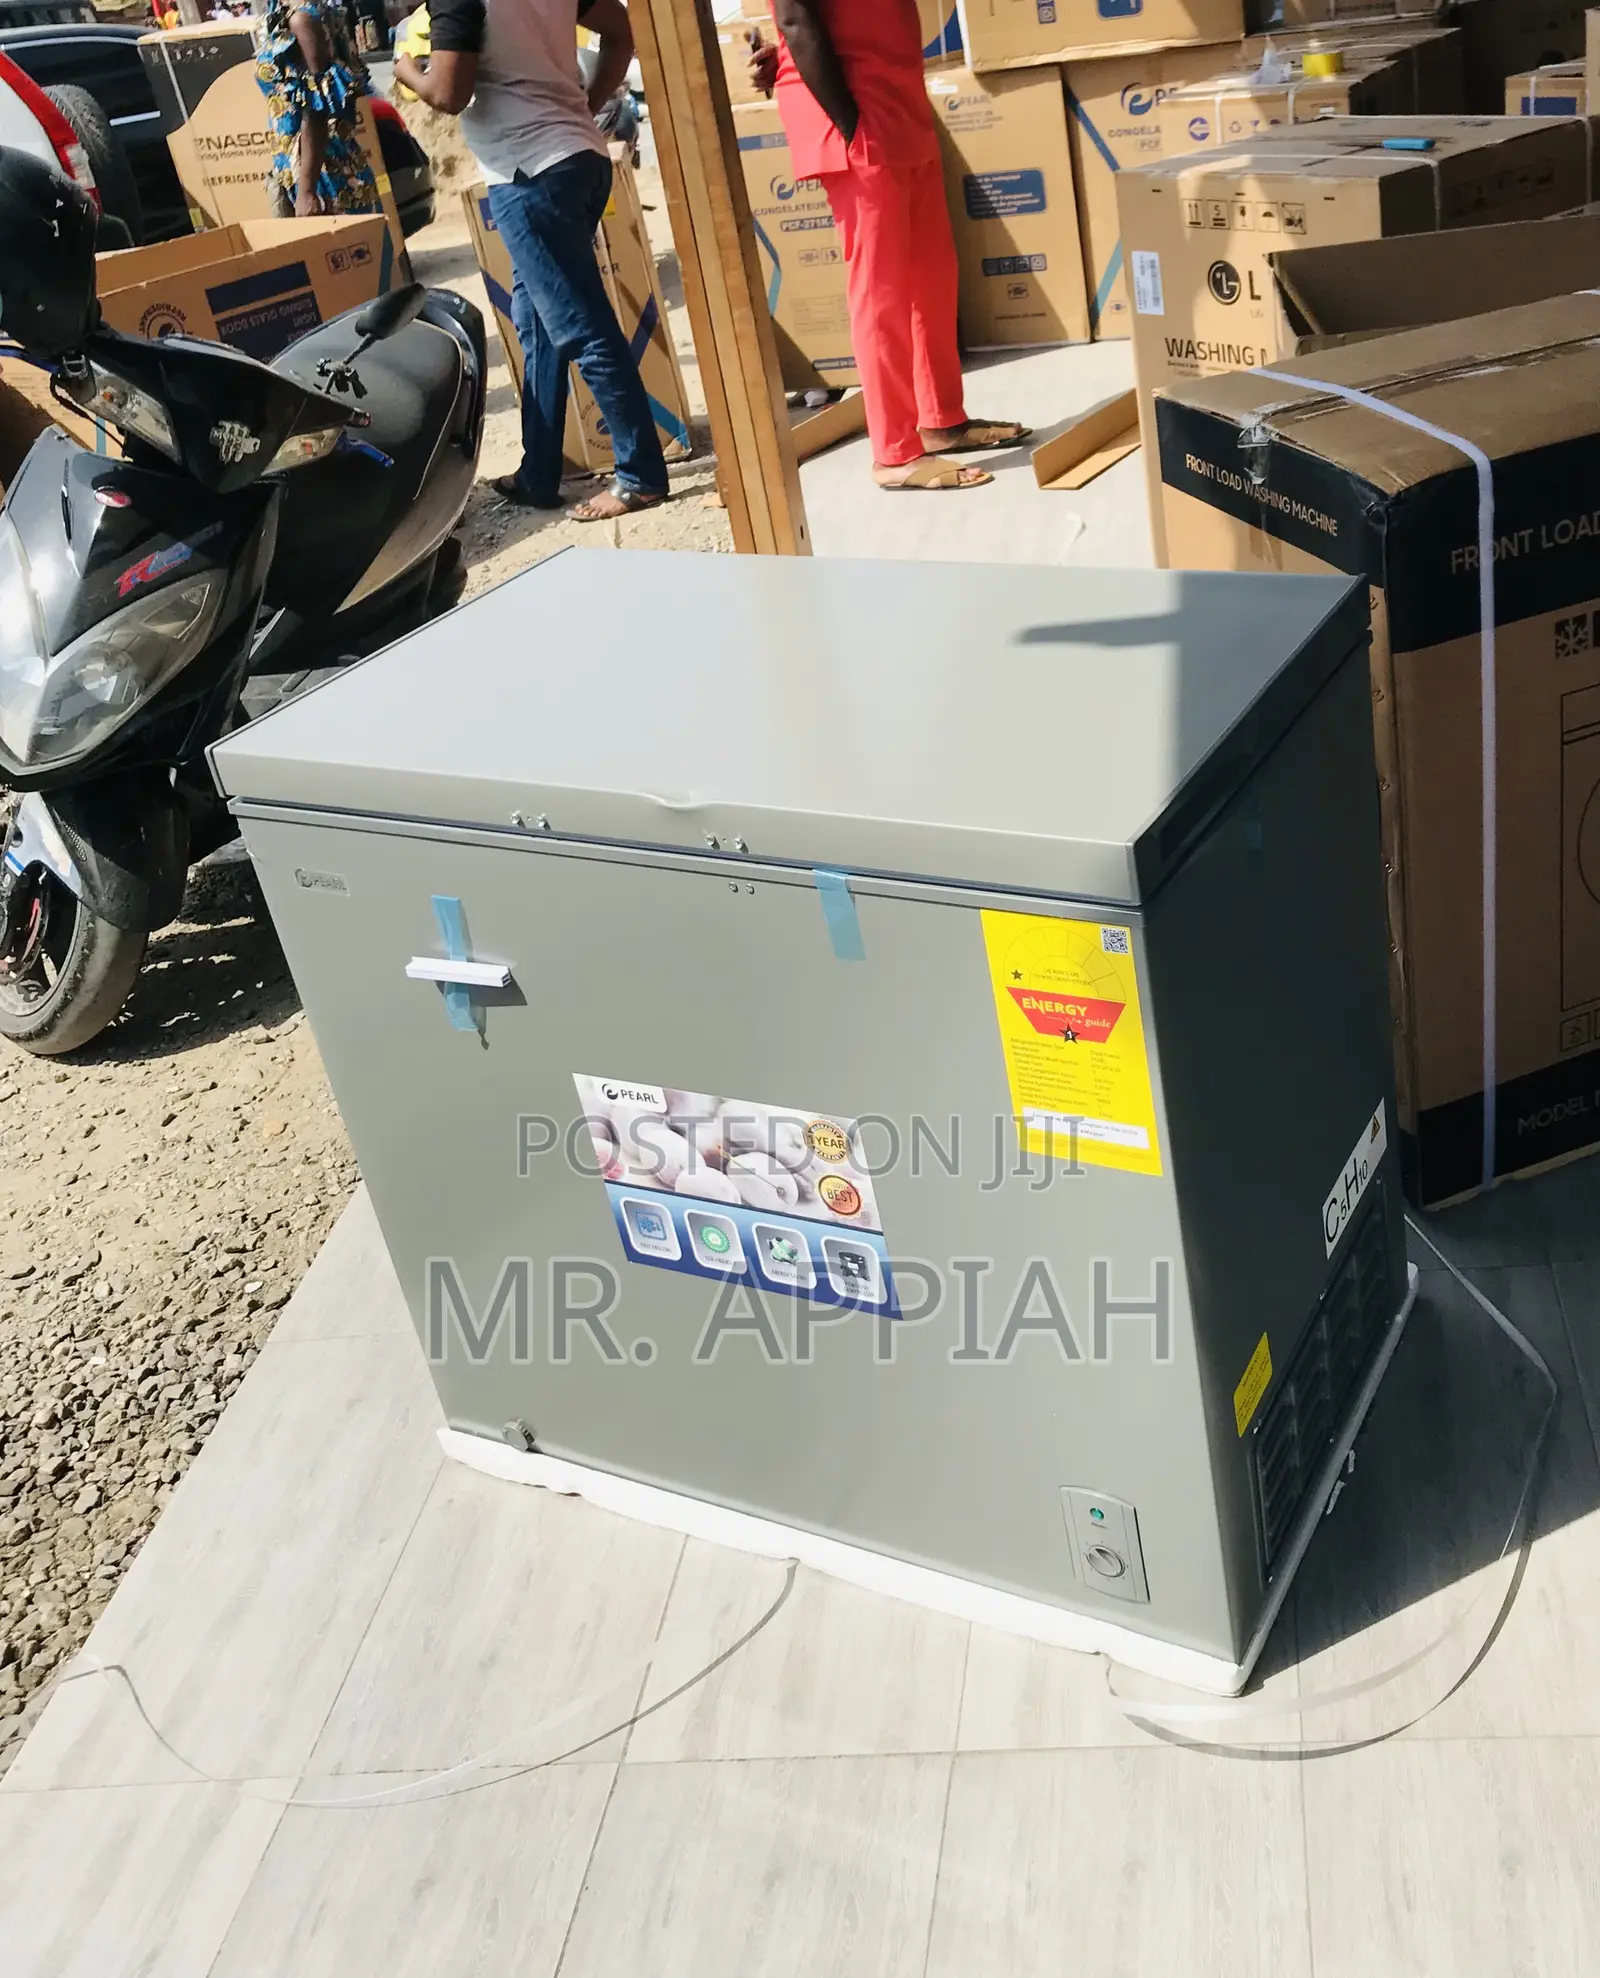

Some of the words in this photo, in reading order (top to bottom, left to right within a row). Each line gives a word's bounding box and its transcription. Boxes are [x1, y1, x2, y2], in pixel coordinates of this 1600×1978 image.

[1107, 125, 1161, 138] CONGELA
[203, 171, 267, 187] REFRIGERA
[220, 317, 247, 336] DOOR
[1164, 337, 1255, 367] WASHING
[1185, 453, 1215, 480] FRONT
[1216, 467, 1242, 491] LOAD
[1243, 477, 1291, 514] WASHING
[1292, 500, 1338, 537] MACHINE
[1022, 995, 1088, 1018] ENERGY
[1084, 1018, 1111, 1029] guide
[620, 1089, 659, 1104] PEARL
[1517, 1096, 1590, 1135] MODEL
[815, 1136, 846, 1150] YEAR
[826, 1188, 853, 1203] BEST
